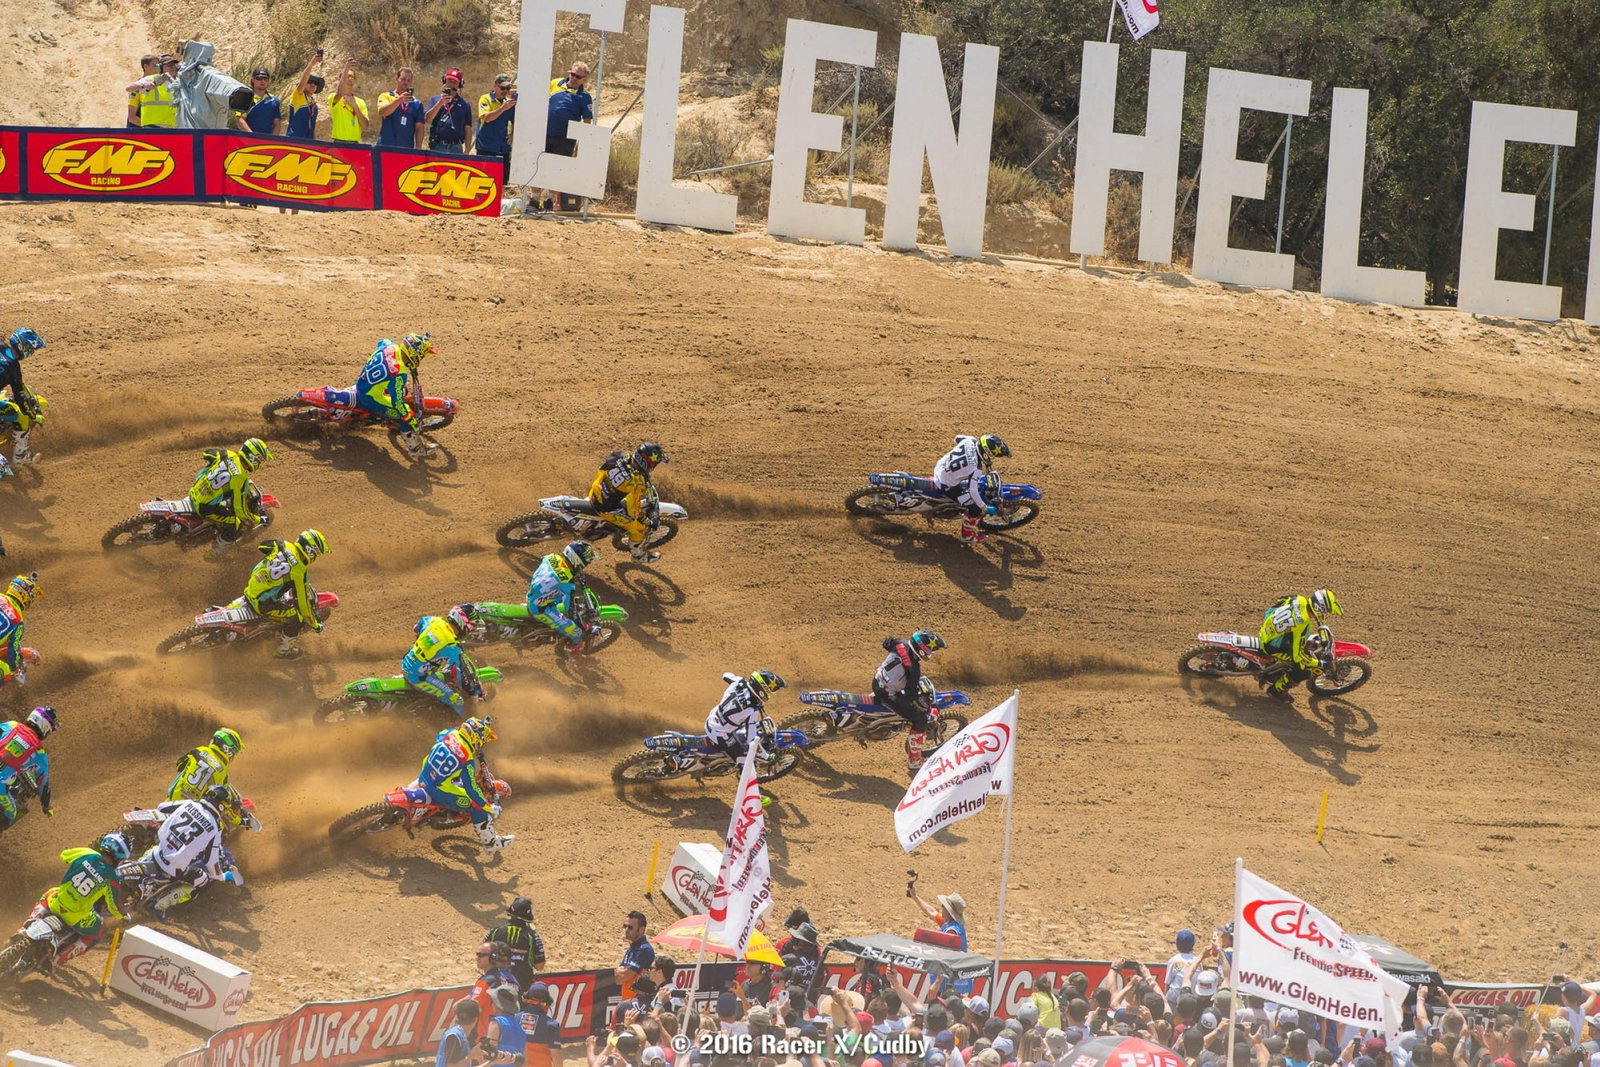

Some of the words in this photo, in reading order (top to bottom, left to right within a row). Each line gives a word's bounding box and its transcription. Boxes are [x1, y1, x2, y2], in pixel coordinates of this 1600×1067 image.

[44, 145, 170, 175] FMF
[226, 152, 352, 186] FMF
[509, 0, 1000, 258] GLEN
[1070, 40, 1600, 327] HELE
[91, 177, 121, 185] RACING
[276, 183, 308, 194] RACING
[399, 169, 495, 200] FMF
[442, 198, 461, 209] RACING
[949, 445, 968, 473] 26
[207, 460, 231, 490] 39
[1271, 604, 1294, 633] 403
[187, 759, 214, 790] 31
[428, 742, 459, 777] 28
[169, 811, 204, 845] 23
[71, 871, 95, 896] 46
[679, 873, 701, 899] GLEN
[135, 958, 168, 986] GLEN
[168, 967, 203, 1002] HELEN
[1239, 970, 1383, 1023] www.GlenHelen.
[1451, 990, 1508, 1007] LUCAS
[1510, 990, 1538, 1009] OIL
[290, 1008, 378, 1064] LUCAS
[371, 1001, 421, 1050] OIL
